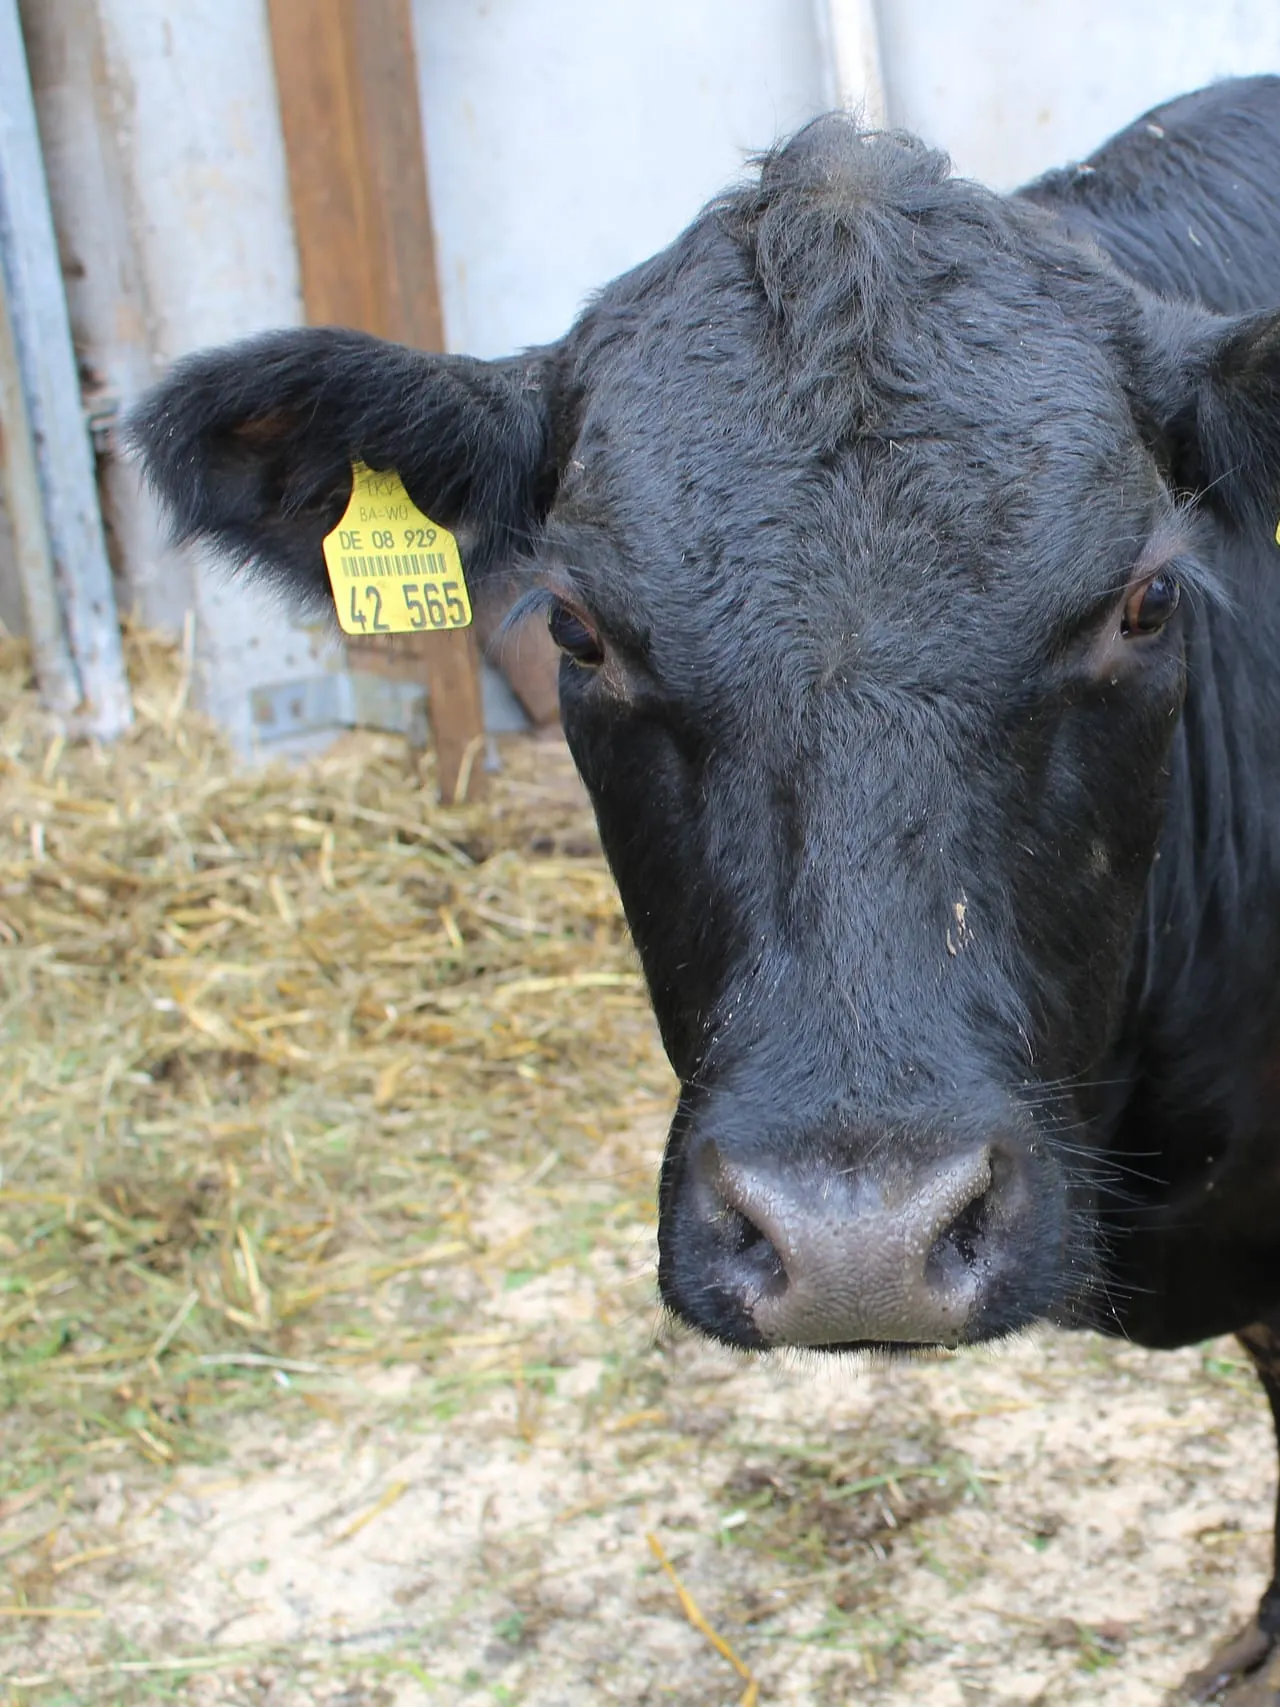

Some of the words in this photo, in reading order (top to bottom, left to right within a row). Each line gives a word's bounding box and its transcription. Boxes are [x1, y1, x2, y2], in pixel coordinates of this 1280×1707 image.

[339, 531, 363, 550] DE
[371, 531, 395, 549] 08
[404, 528, 437, 548] 929
[351, 585, 390, 632] 42
[402, 581, 467, 629] 565
